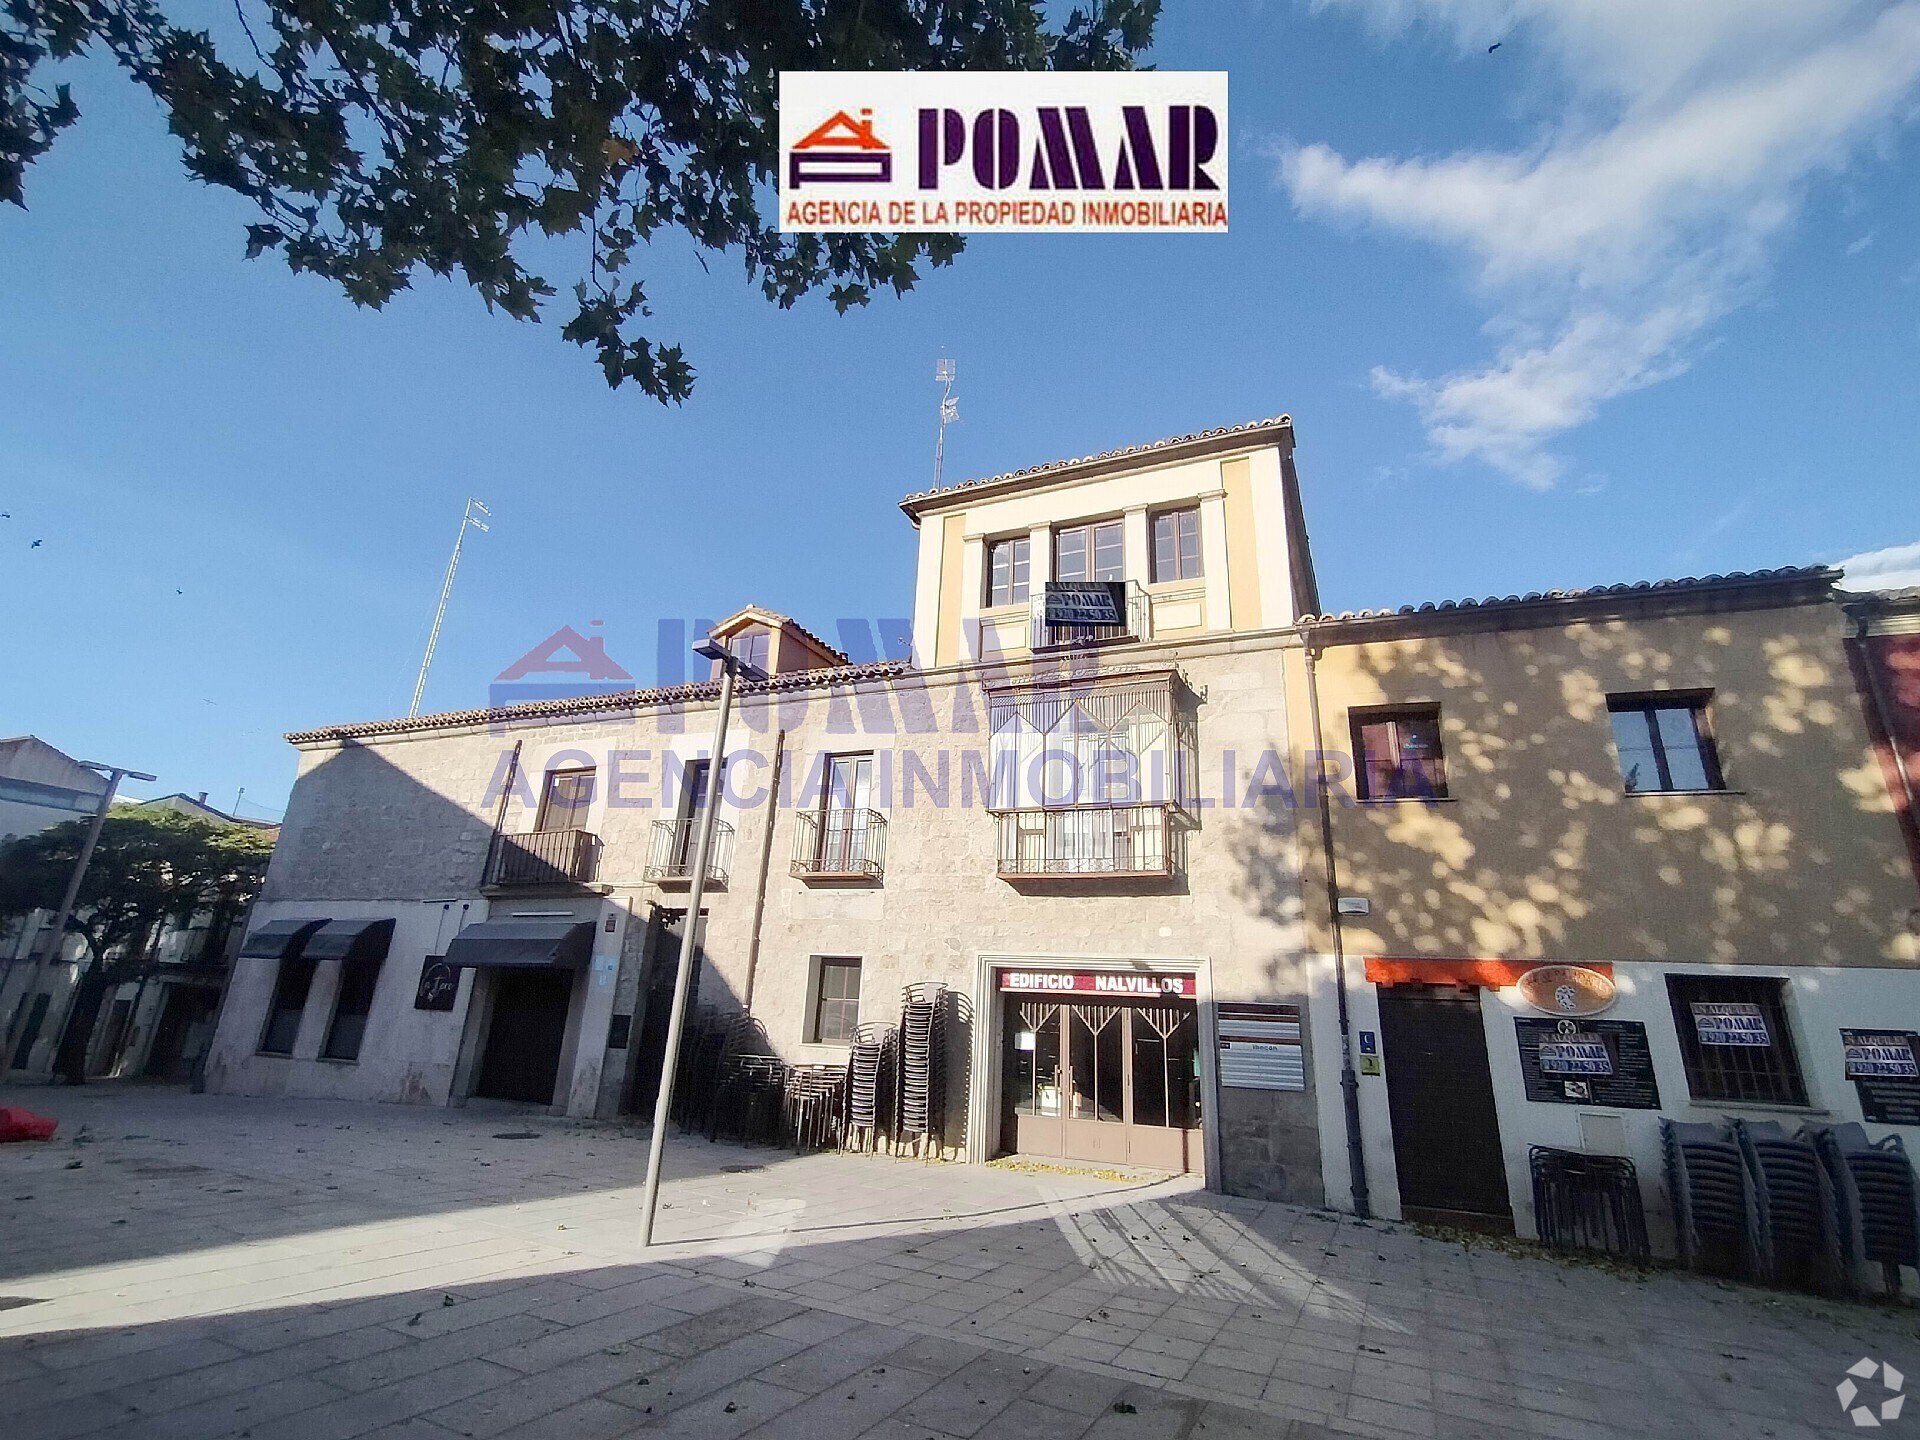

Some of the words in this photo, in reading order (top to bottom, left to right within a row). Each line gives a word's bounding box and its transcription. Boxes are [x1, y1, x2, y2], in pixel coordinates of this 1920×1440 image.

[1009, 973, 1075, 990] EDIFICIO
[1095, 975, 1184, 994] NALVILLOS
[1713, 1017, 1765, 1030] POMAR
[1741, 1033, 1753, 1043] 50
[1755, 1033, 1767, 1043] 35
[1556, 1045, 1607, 1059] POMAR
[1862, 1048, 1913, 1061] POMAR
[1583, 1062, 1596, 1071] 50
[1598, 1062, 1610, 1072] 35
[1889, 1064, 1902, 1074] 50
[1903, 1064, 1915, 1074] 35
